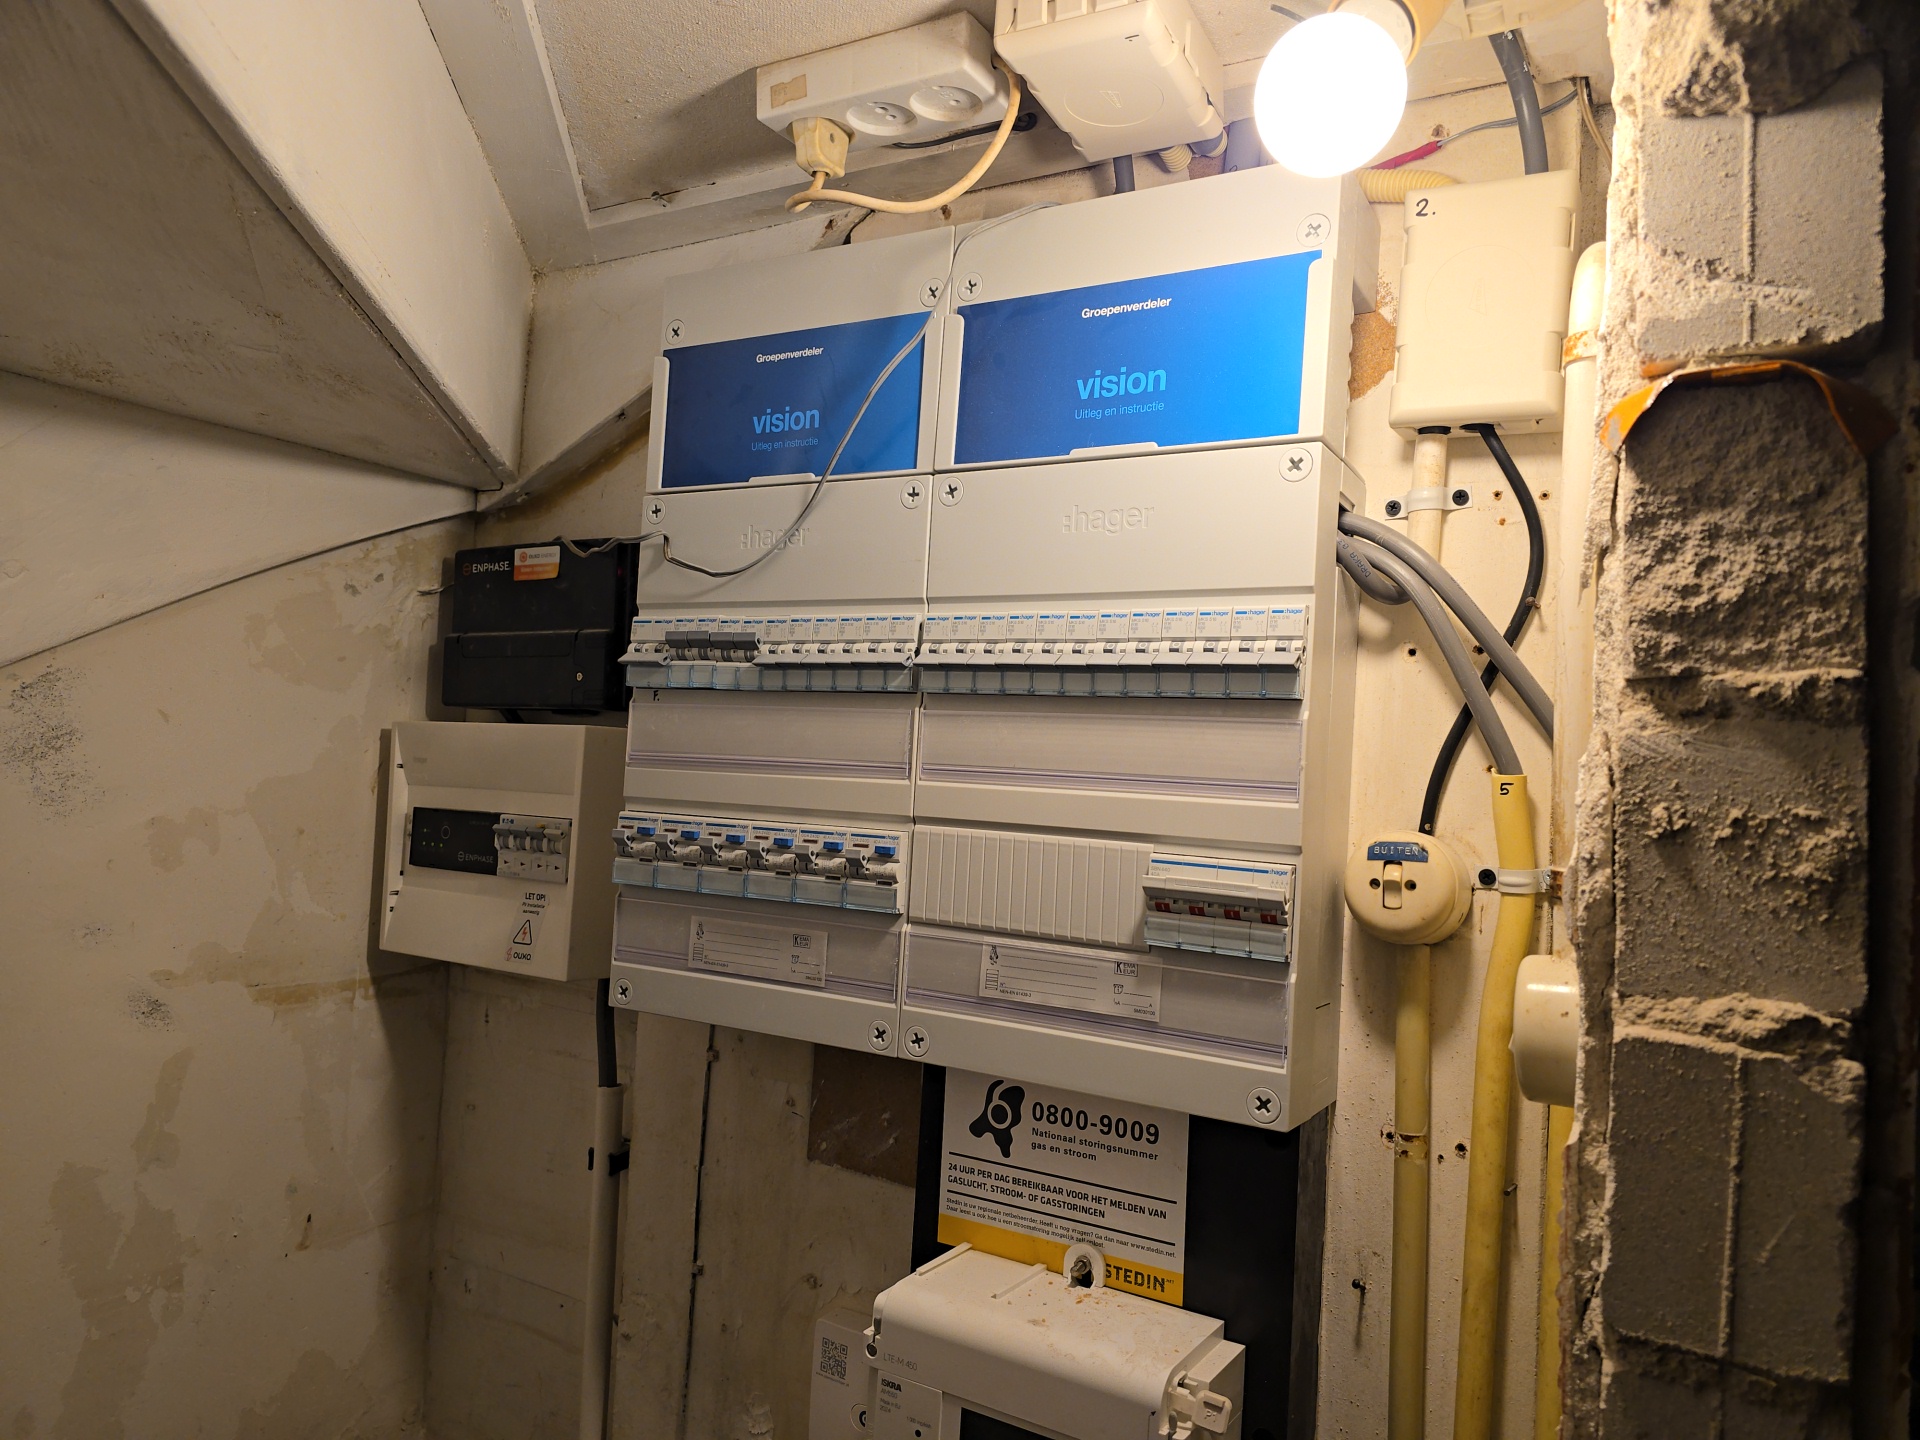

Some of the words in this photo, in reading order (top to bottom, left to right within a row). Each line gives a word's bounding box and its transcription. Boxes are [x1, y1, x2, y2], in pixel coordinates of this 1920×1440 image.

[1081, 297, 1172, 319] Groepenverdeler
[756, 346, 824, 363] Groepenverdeler
[1076, 366, 1166, 400] vision
[752, 406, 820, 434] vision
[1075, 407, 1102, 420] Uitleg
[1104, 406, 1117, 416] en
[1119, 400, 1165, 415] instructie
[751, 442, 772, 452] Uitleg
[773, 440, 783, 449] en
[785, 436, 819, 448] instructie
[472, 561, 510, 573] ENPHASE
[1349, 551, 1372, 578] DRAKA
[1500, 782, 1514, 796] 5
[465, 853, 494, 863] ENPHASE
[1373, 846, 1419, 856] BUITEN
[525, 892, 536, 900] LET
[1031, 1101, 1160, 1145] 0800-9009
[1031, 1127, 1076, 1144] Nationaal
[1079, 1138, 1159, 1161] storingsnummer
[1031, 1141, 1047, 1152] gas
[1050, 1146, 1061, 1154] en
[1063, 1148, 1097, 1161] stroom
[947, 1175, 989, 1193] GASLUCHT,
[990, 1184, 1027, 1200] STROOM-
[1028, 1193, 1039, 1203] OF
[1040, 1195, 1106, 1219] GASSTORINGEN
[948, 1163, 958, 1172] 24
[959, 1165, 976, 1176] UUR
[977, 1169, 992, 1180] PER
[994, 1173, 1010, 1184] DAG
[1012, 1176, 1064, 1196] BEREIKBAAR
[1065, 1188, 1090, 1202] VOOR
[1091, 1194, 1108, 1206] HET
[1109, 1198, 1146, 1215] MELDEN
[1147, 1207, 1167, 1220] VAN
[946, 1197, 962, 1206] Stedin
[977, 1205, 1002, 1216] regionale
[1002, 1211, 1038, 1224] netbeheerder.
[1040, 1220, 1054, 1228] Heeft
[1060, 1225, 1070, 1233] nog
[1071, 1229, 1094, 1238] vragen?
[1104, 1235, 1114, 1243] dan
[1116, 1239, 1129, 1247] naar
[946, 1204, 958, 1212] Daar
[960, 1208, 971, 1216] leest
[987, 1214, 997, 1222] hoe
[1051, 1231, 1074, 1241] mogelijk
[1106, 1262, 1165, 1293] STEDIN
[883, 1352, 904, 1367] LTE-M
[905, 1361, 918, 1371] 450
[881, 1378, 902, 1392] ISKRA
